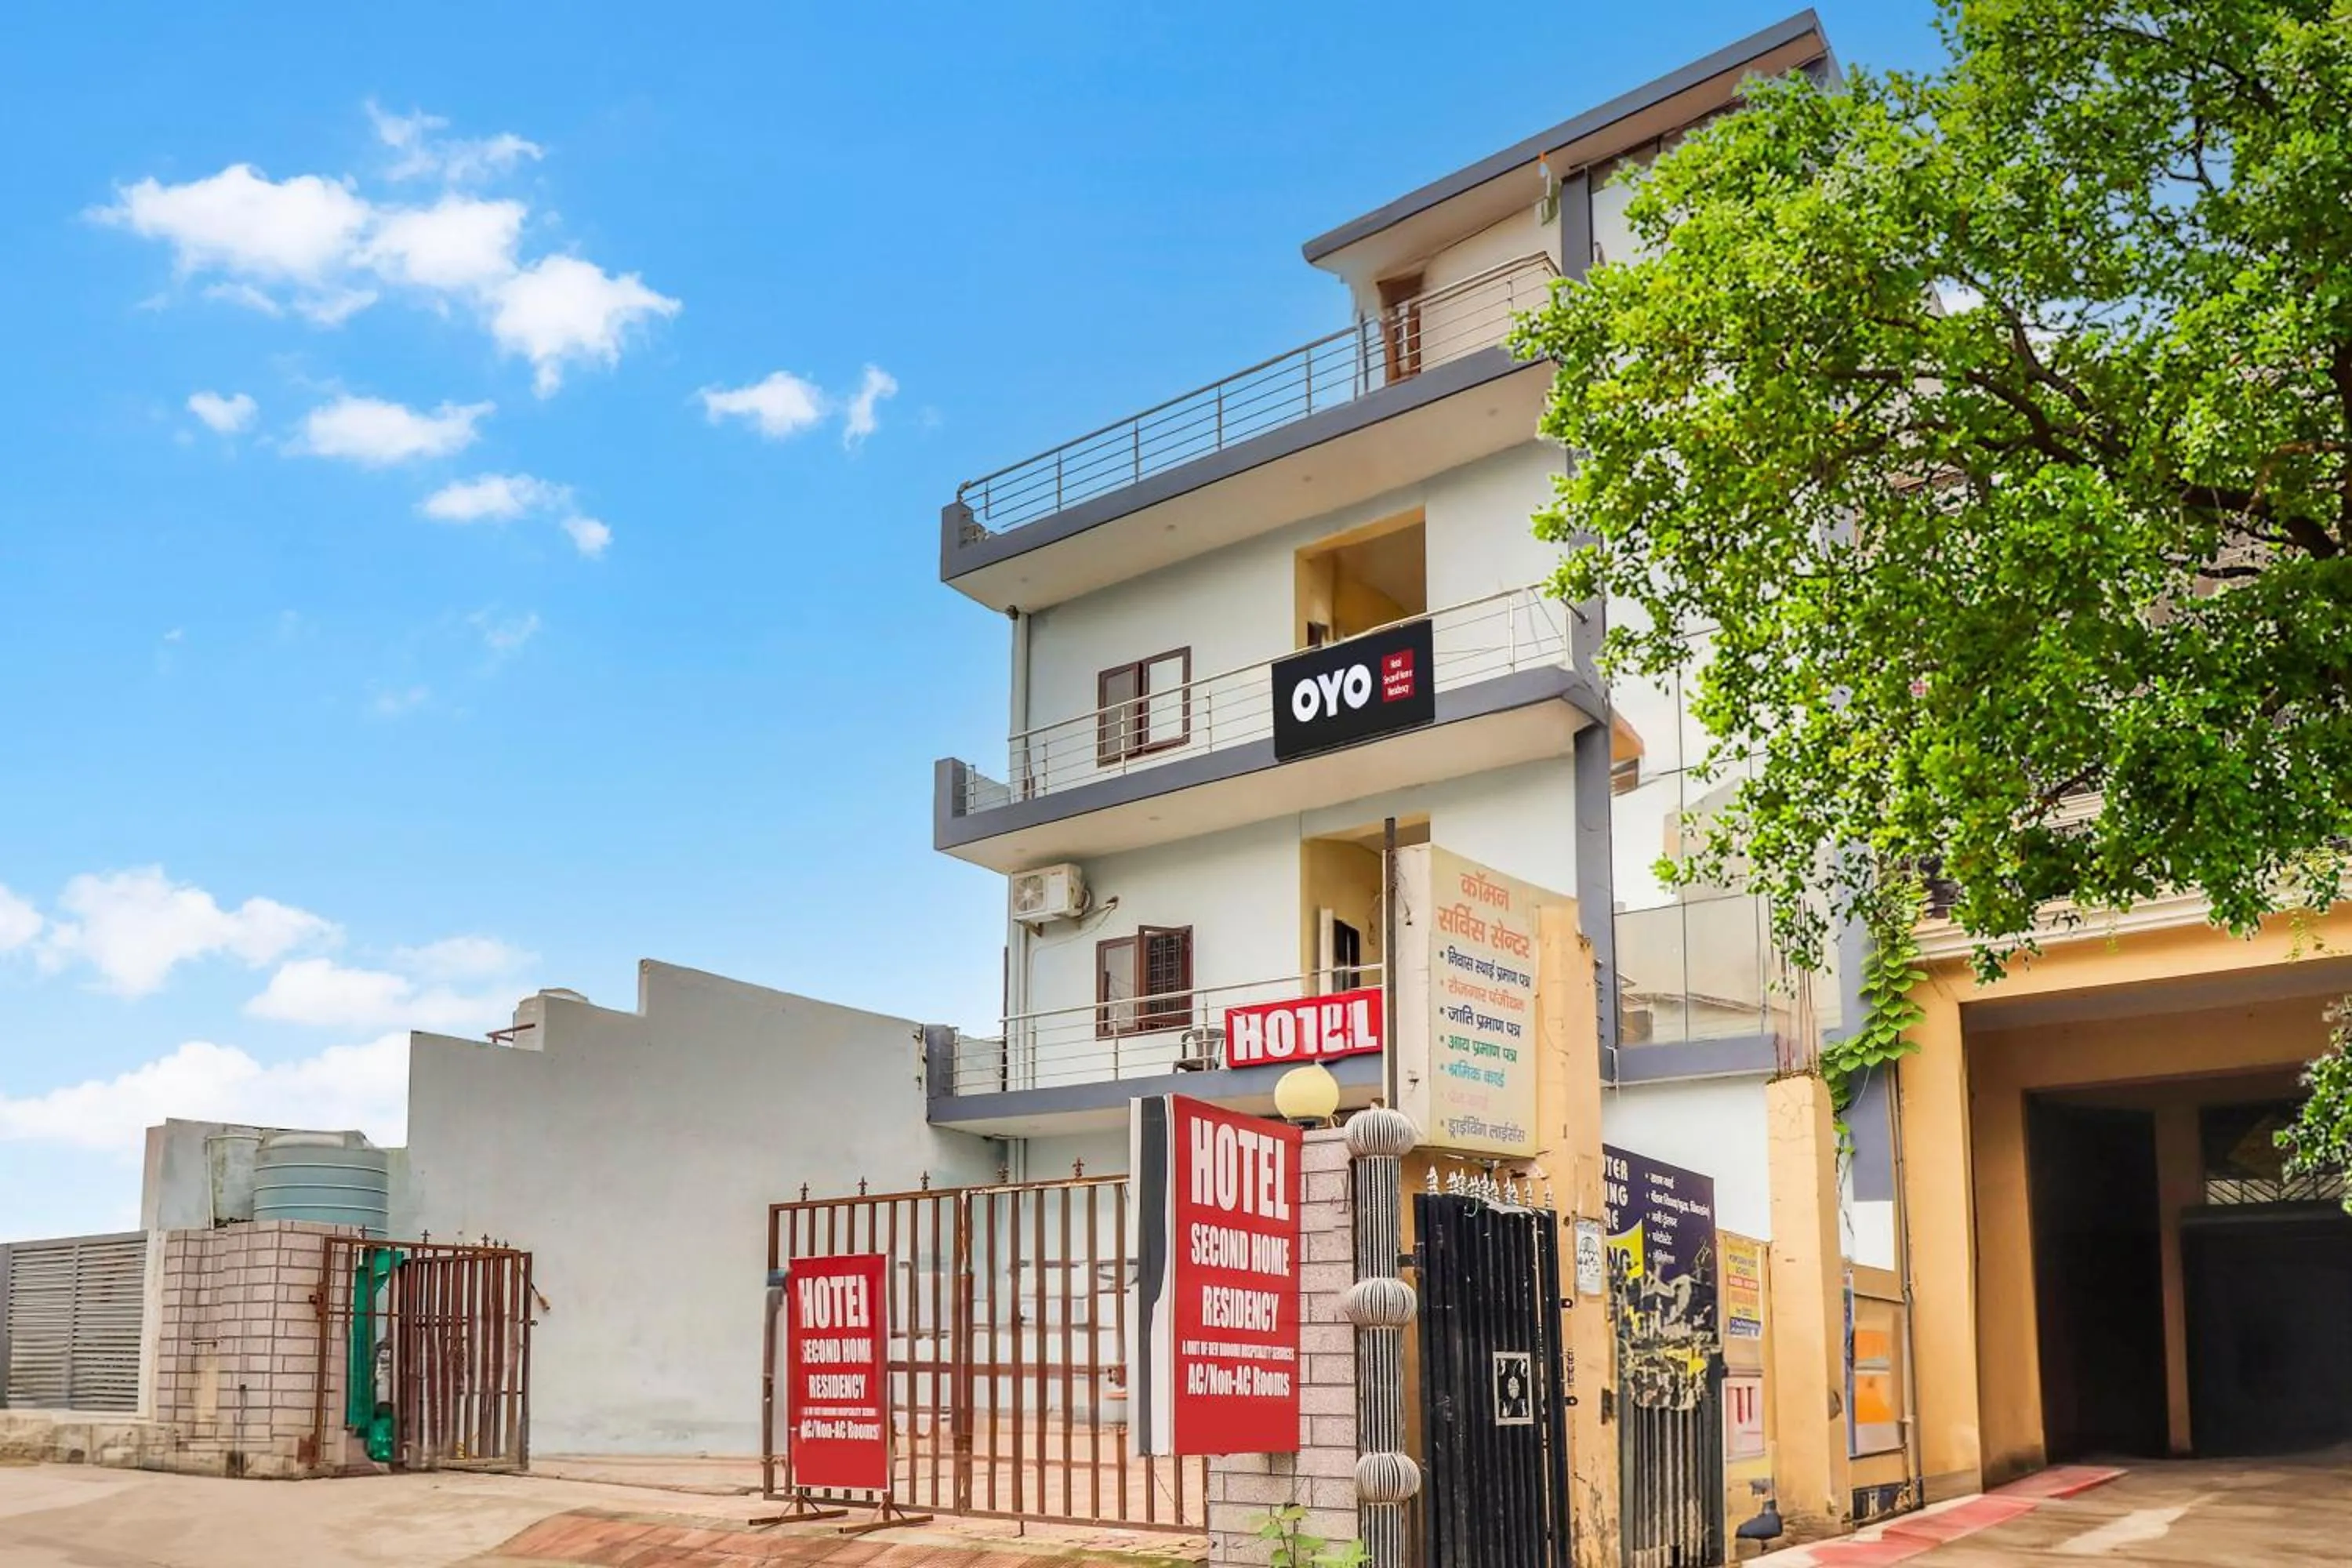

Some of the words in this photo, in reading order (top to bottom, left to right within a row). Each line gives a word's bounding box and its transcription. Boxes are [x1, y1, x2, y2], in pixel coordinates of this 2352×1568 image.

[1292, 664, 1372, 722] OYO
[1459, 871, 1510, 912] कॉमन
[1437, 903, 1486, 943] सर्विस
[1490, 918, 1530, 959] सेन्टर
[1232, 999, 1377, 1061] HOTEL
[1447, 1004, 1474, 1025] जाति
[1476, 1013, 1504, 1034] प्रमाण
[1506, 1021, 1521, 1039] पत्र
[1448, 1034, 1470, 1052] आय
[1503, 1047, 1518, 1063] पत्र
[1191, 1116, 1290, 1221] HOTEL
[1191, 1222, 1249, 1271] SECOND
[1251, 1232, 1290, 1276] HOME
[797, 1274, 869, 1329] HOTEL
[1202, 1285, 1279, 1332] RESIDENCY
[801, 1338, 840, 1363] SECOND
[808, 1374, 866, 1399] RESIDENCY
[1188, 1363, 1251, 1396] AC/Non-AC
[1253, 1367, 1290, 1396] Rooms
